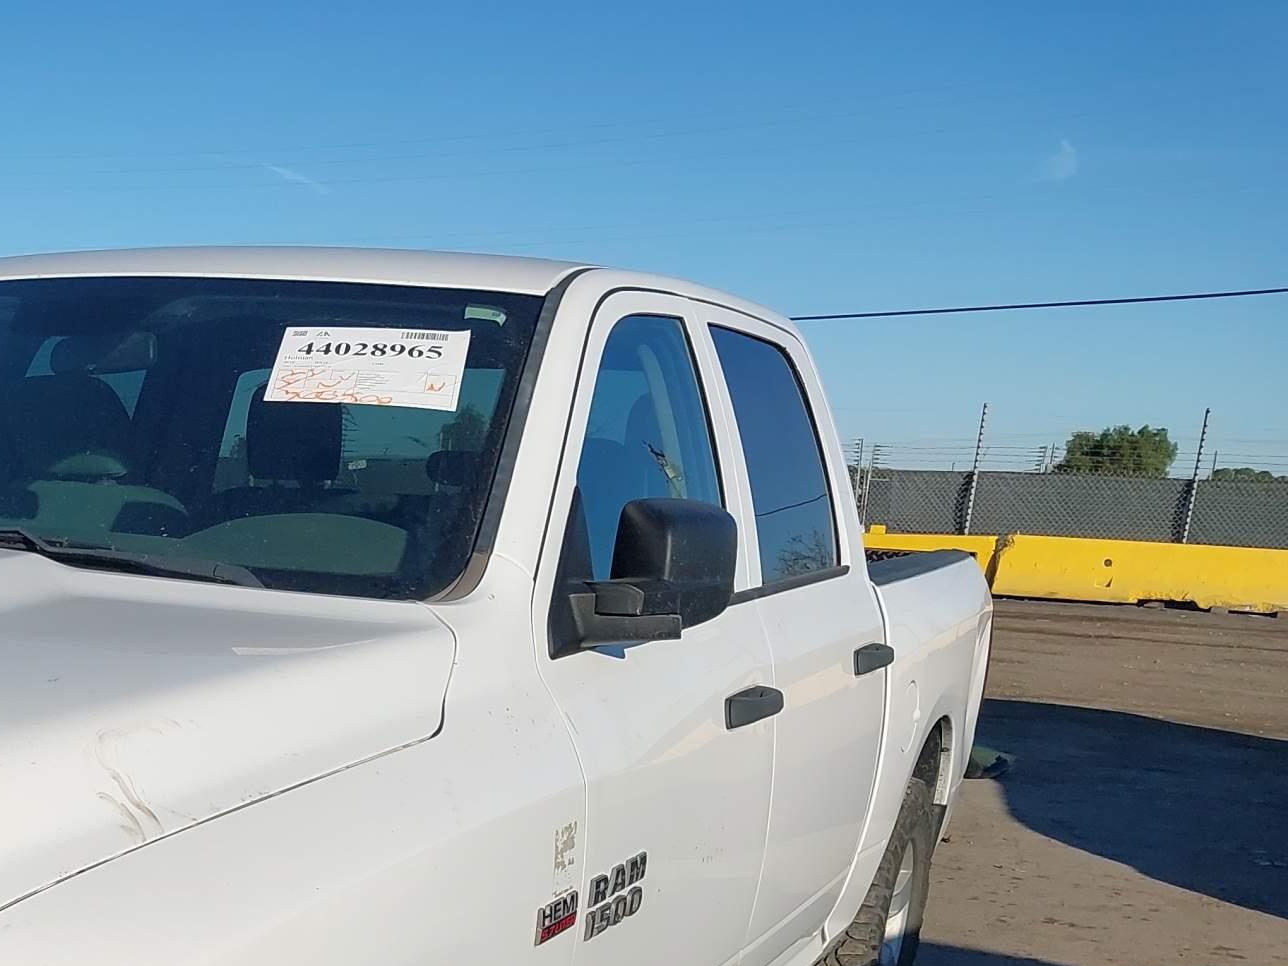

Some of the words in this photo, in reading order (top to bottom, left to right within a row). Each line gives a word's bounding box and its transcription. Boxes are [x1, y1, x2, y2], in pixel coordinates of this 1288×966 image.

[297, 341, 444, 360] 44028965
[588, 850, 647, 908] RAM
[584, 886, 643, 942] 1500
